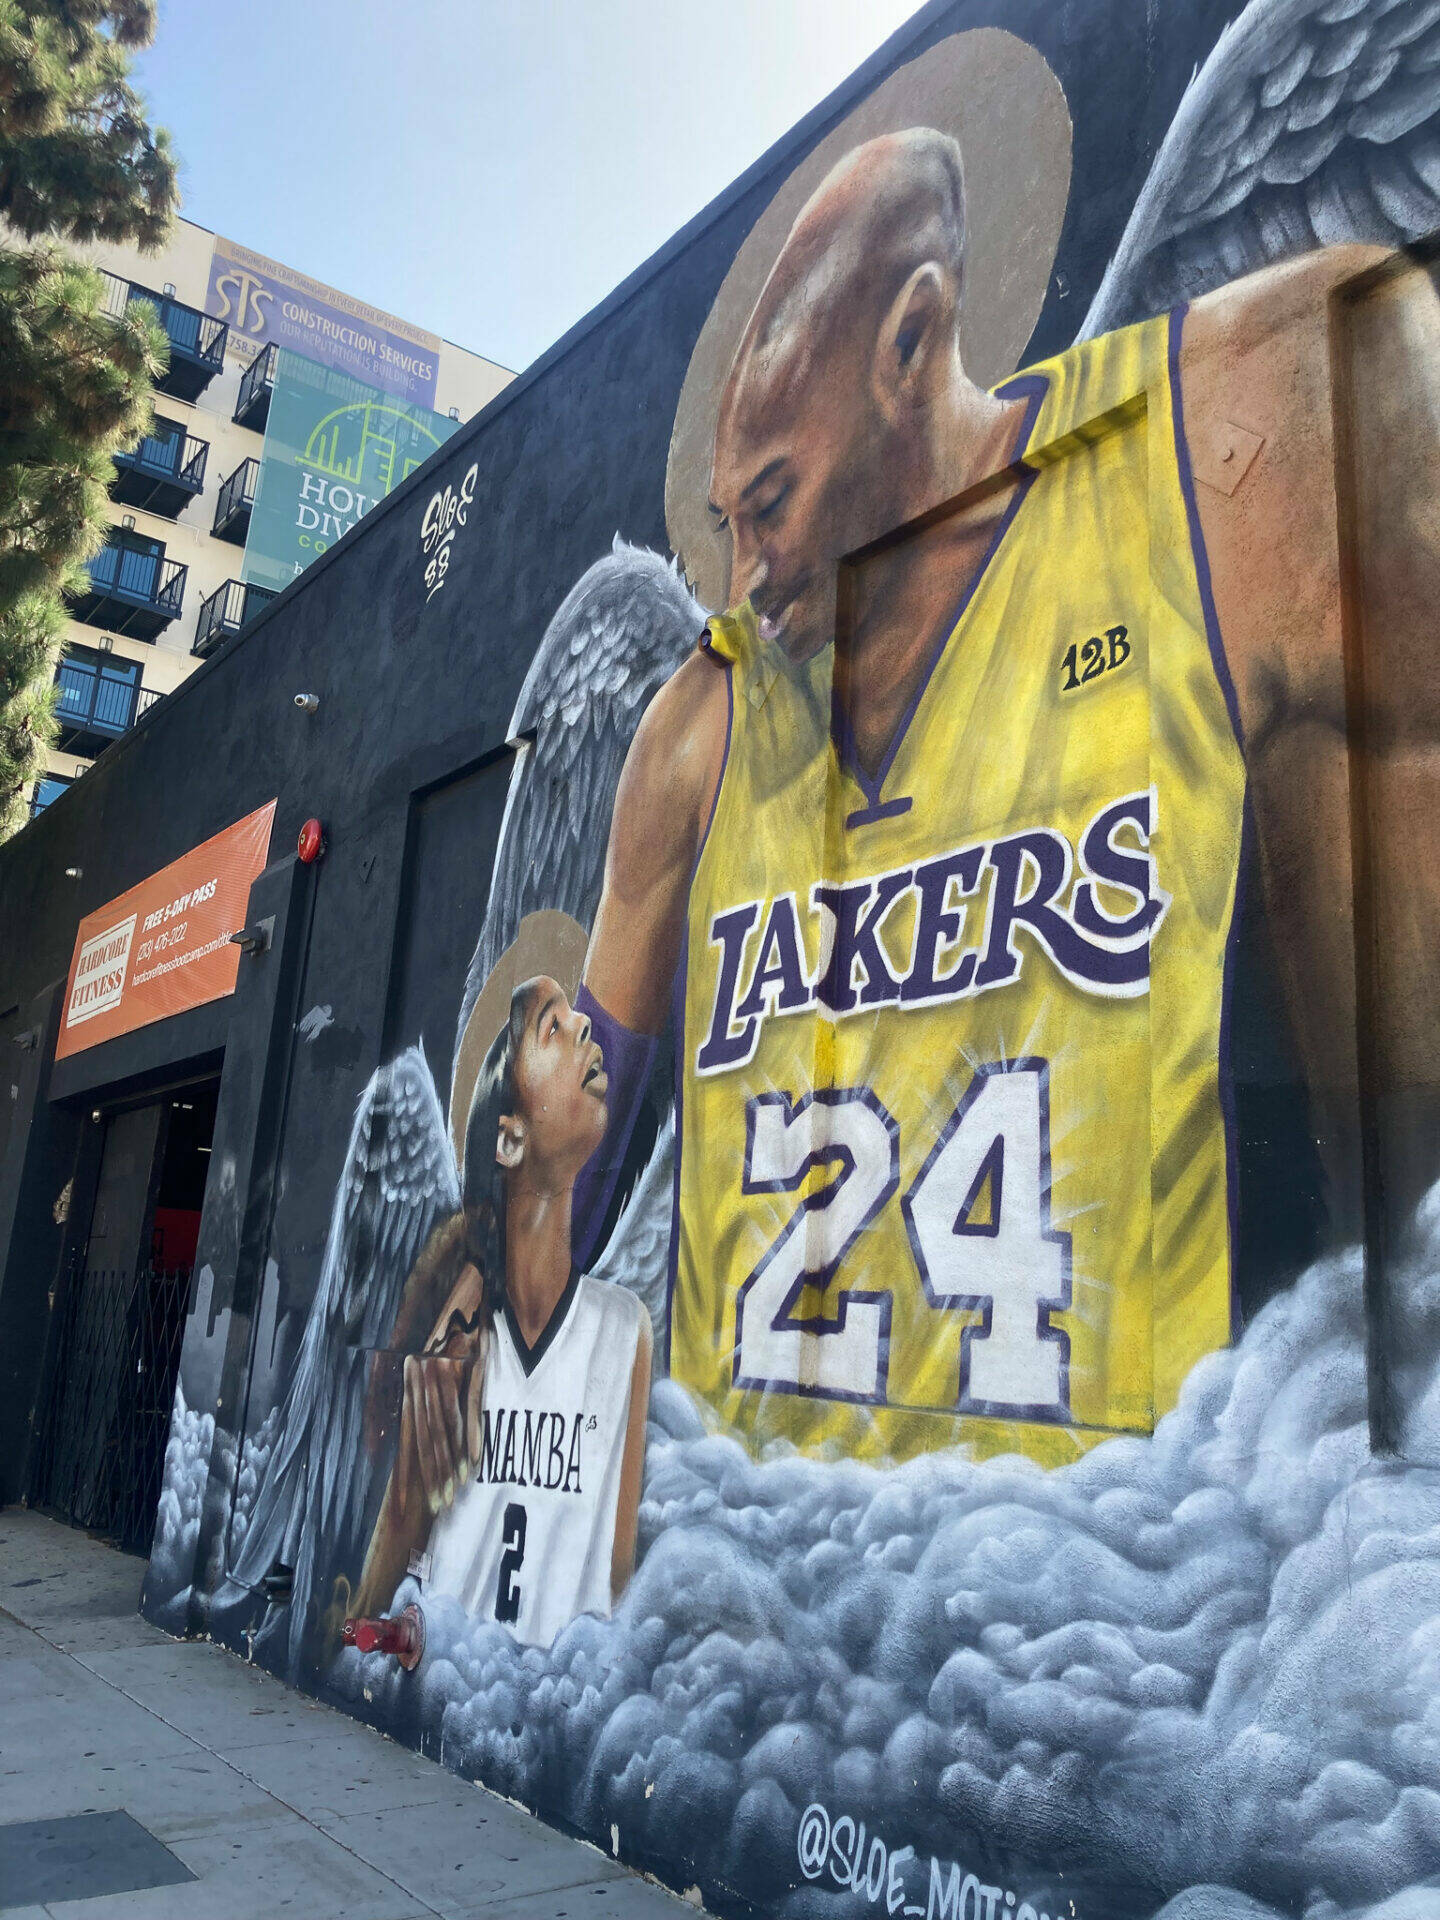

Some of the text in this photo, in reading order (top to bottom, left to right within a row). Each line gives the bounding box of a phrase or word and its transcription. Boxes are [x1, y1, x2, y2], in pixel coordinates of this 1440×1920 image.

[216, 268, 273, 333] STS
[282, 301, 432, 381] CONSTRUCTION SERVICES
[1060, 625, 1131, 691] 12B
[141, 907, 164, 934] FREE
[190, 878, 218, 908] PASS
[695, 783, 1173, 1077] LAKERS
[71, 966, 124, 1010] FITNESS
[78, 933, 130, 977] HARDCORE
[732, 1055, 1075, 1424] 24
[476, 1408, 584, 1494] MAMBA
[494, 1501, 528, 1627] 2
